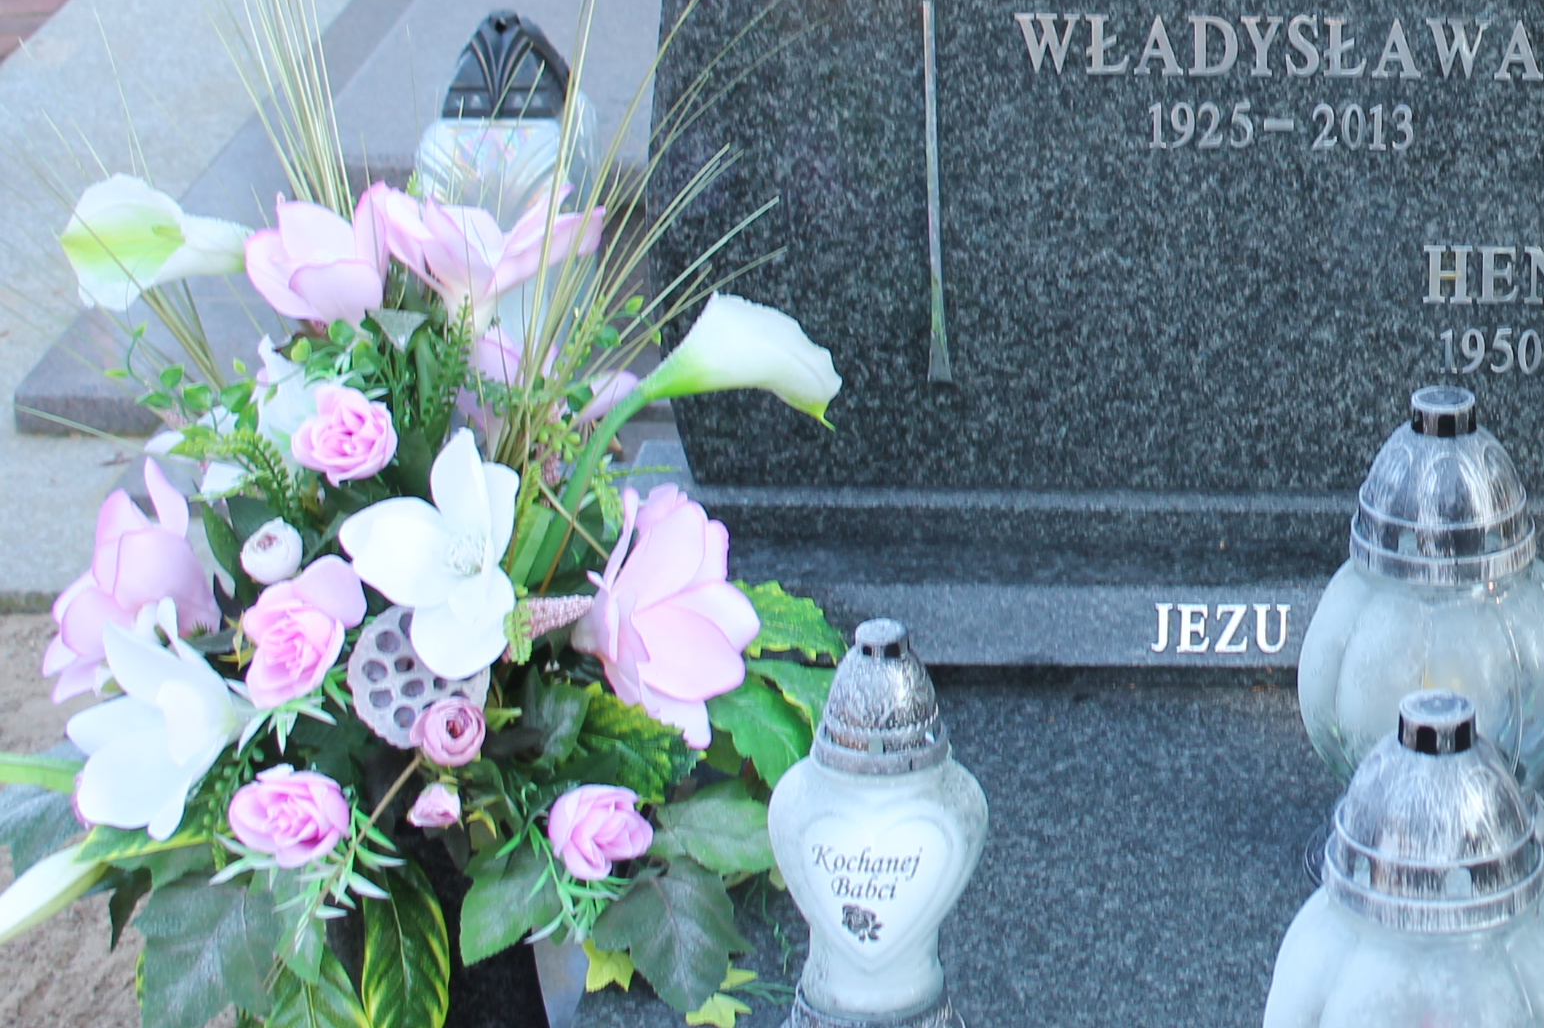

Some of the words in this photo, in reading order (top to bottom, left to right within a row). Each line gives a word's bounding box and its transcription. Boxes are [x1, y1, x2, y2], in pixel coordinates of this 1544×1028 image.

[1014, 12, 1544, 81] WŁADYSŁAWA
[1151, 602, 1291, 654] JEZU
[811, 843, 924, 881] Kochanej
[831, 875, 898, 901] Babci
